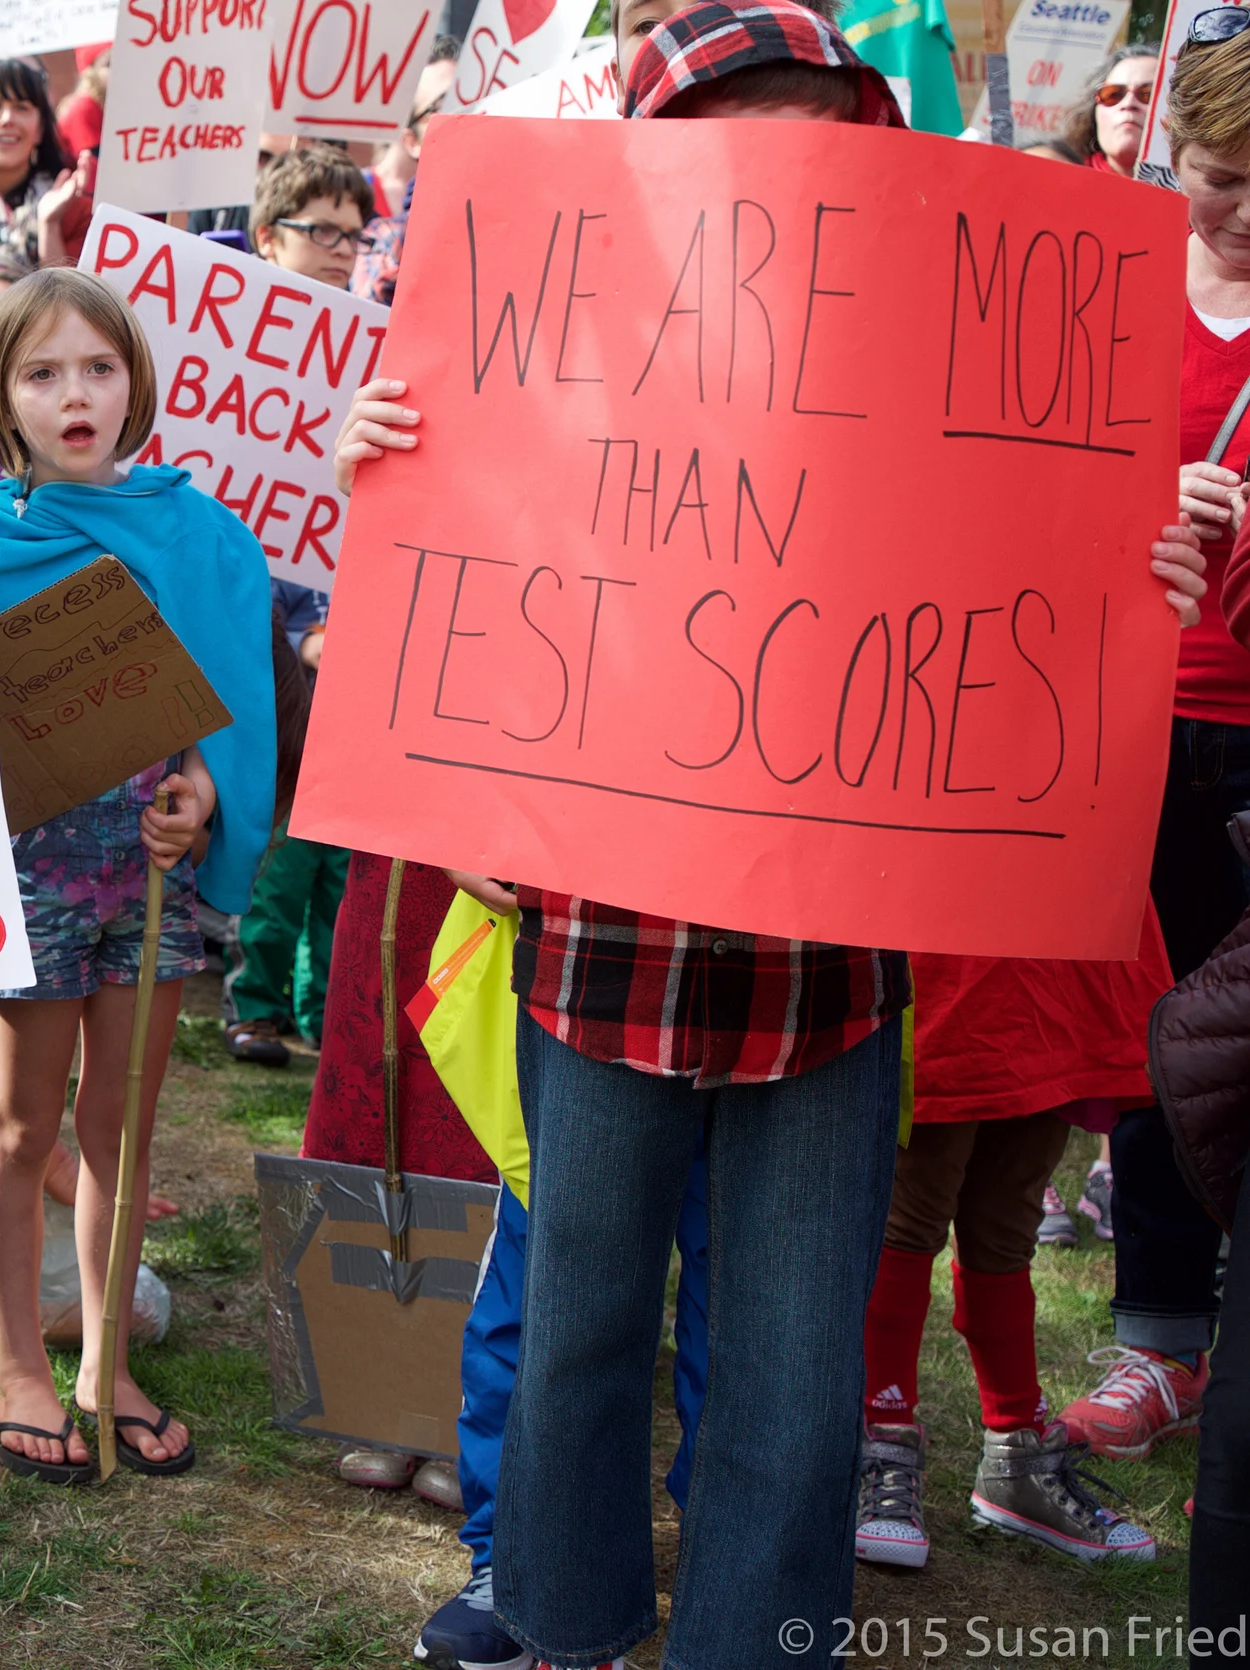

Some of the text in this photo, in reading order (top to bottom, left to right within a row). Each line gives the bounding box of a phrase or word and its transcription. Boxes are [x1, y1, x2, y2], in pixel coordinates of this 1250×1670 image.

[1031, 0, 1111, 25] Seattle
[158, 56, 225, 108] OUR
[1026, 59, 1063, 87] ON
[115, 124, 245, 162] TEACHERS
[467, 199, 1151, 447] WE ARE MORE
[166, 355, 332, 458] BACK
[588, 438, 807, 567] THAN
[10, 661, 158, 742] Love
[389, 542, 1109, 811] TEST SCORES!
